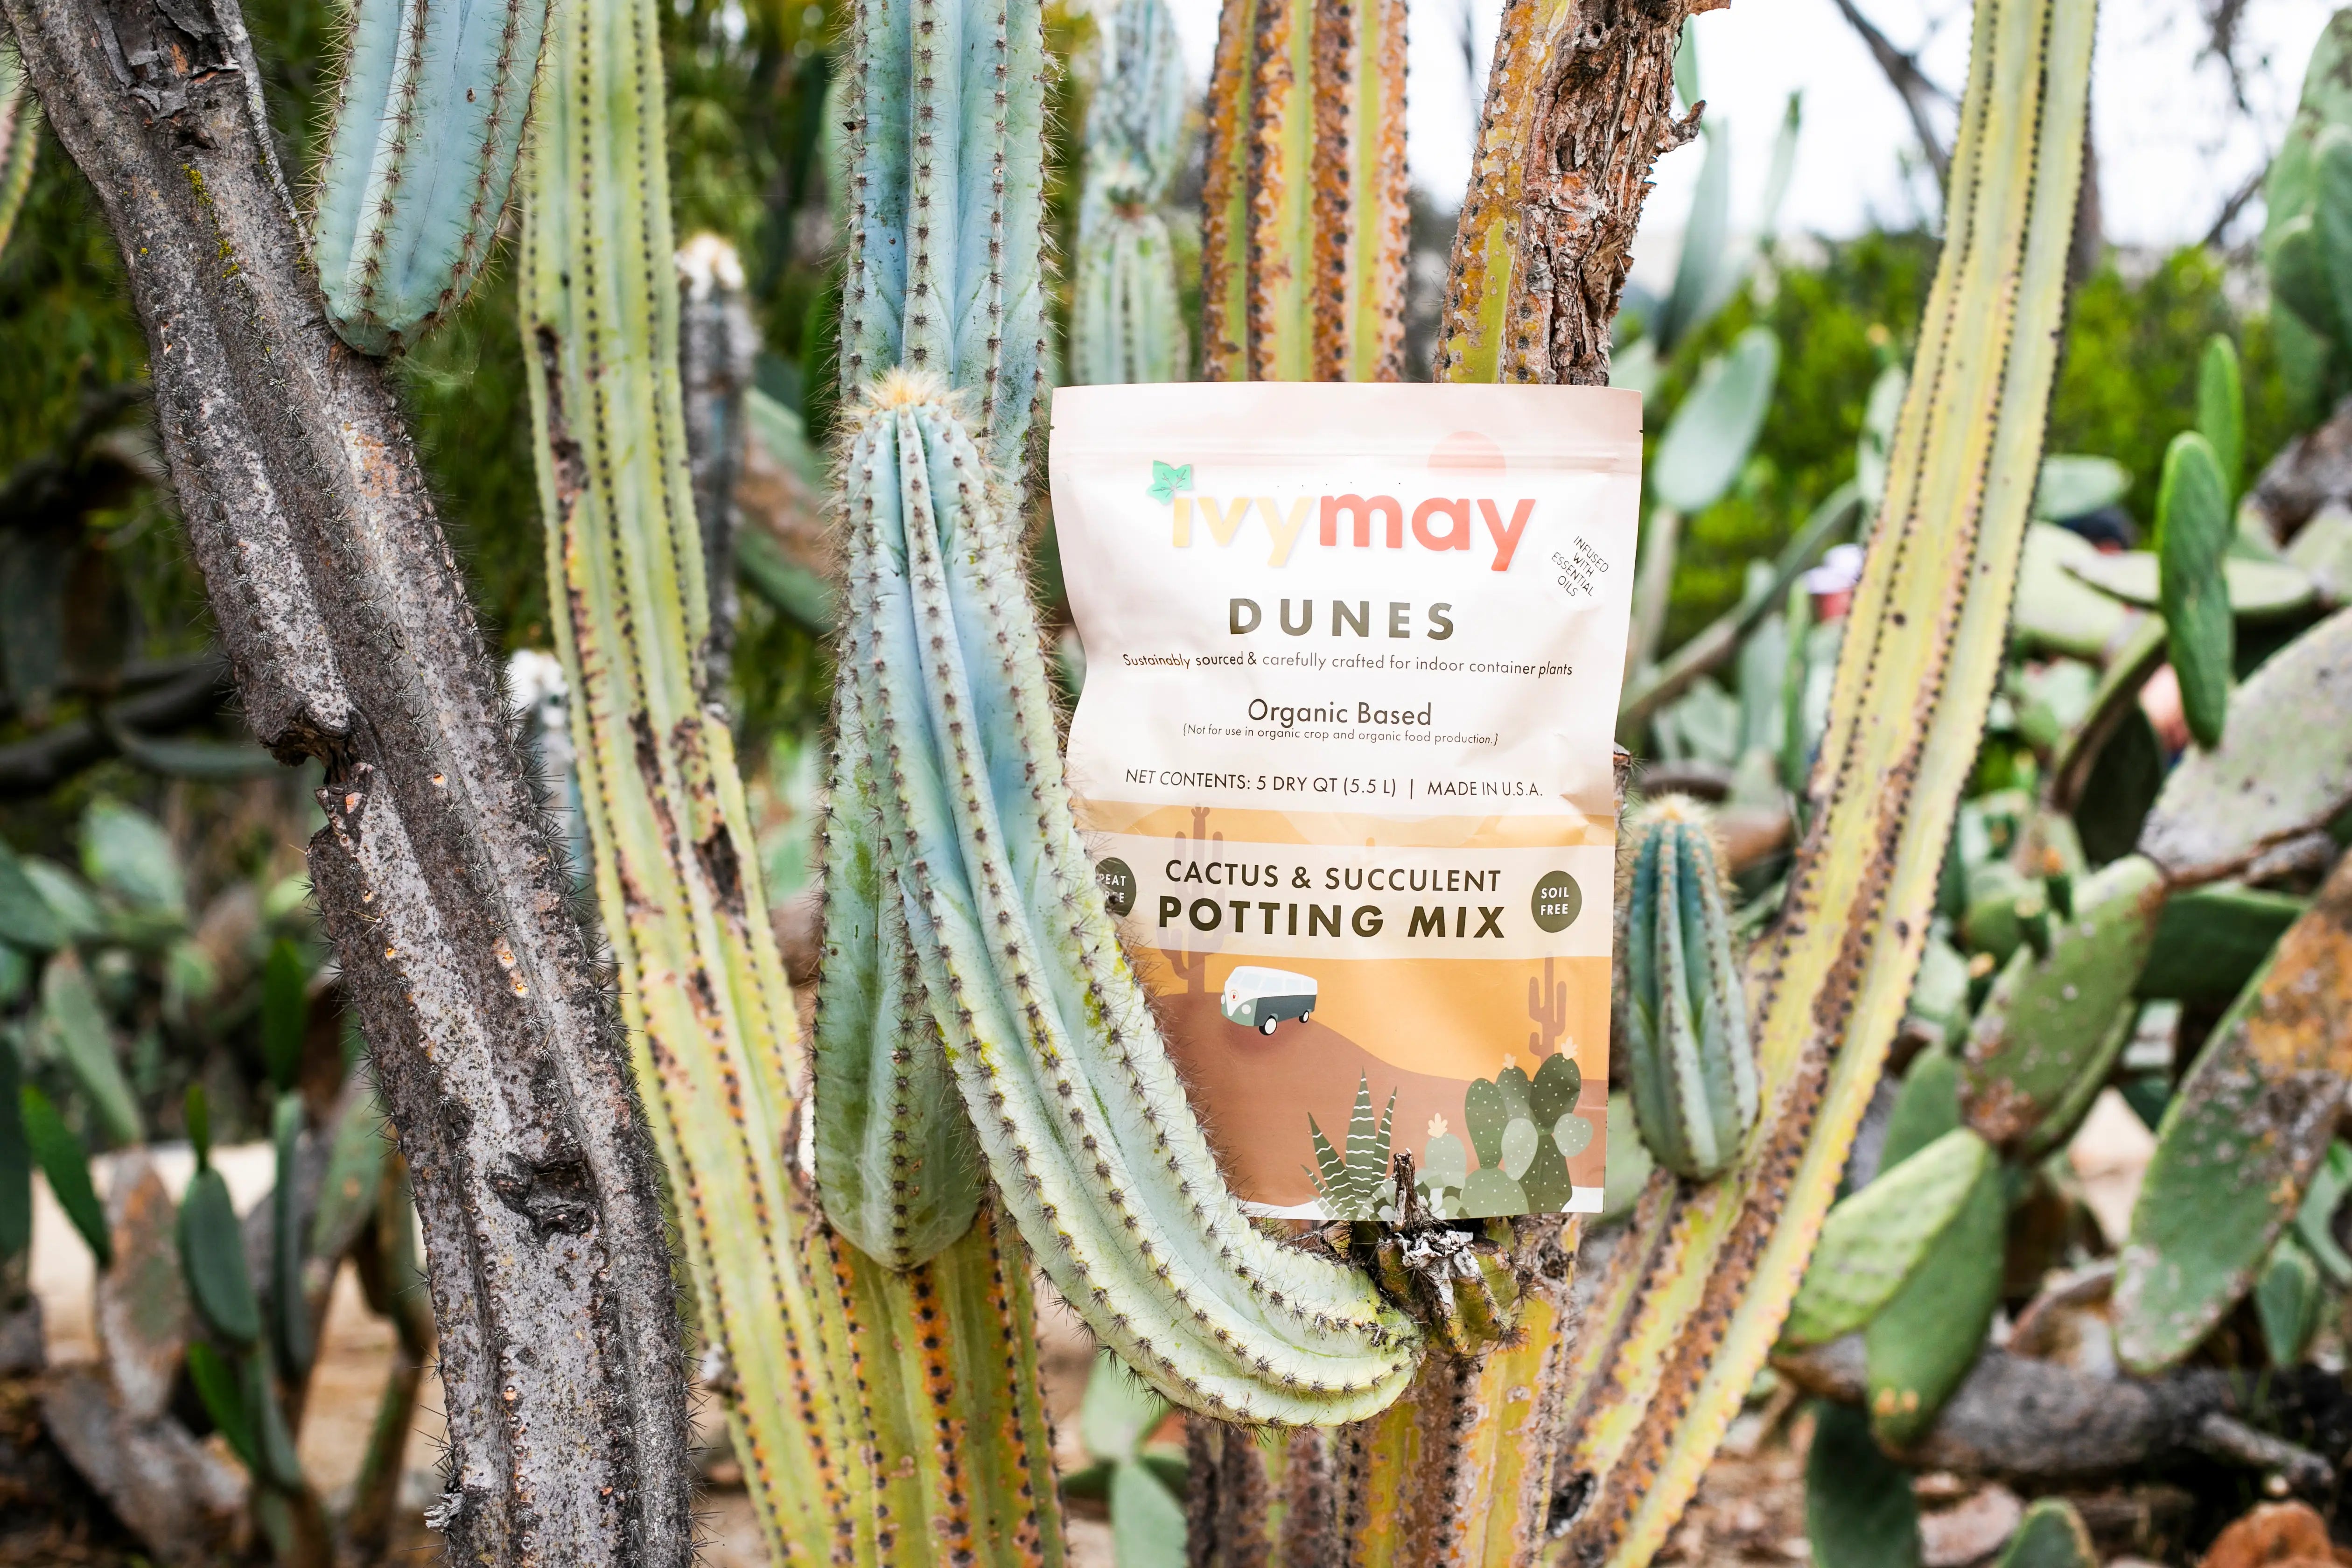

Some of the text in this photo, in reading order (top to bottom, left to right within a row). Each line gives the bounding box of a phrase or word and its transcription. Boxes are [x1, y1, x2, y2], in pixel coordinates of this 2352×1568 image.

[1172, 494, 1536, 572] ivymay
[1573, 552, 1594, 577] WITH
[1574, 536, 1609, 572] INFUSED
[1551, 552, 1593, 596] ESSENTIAL
[1558, 575, 1578, 596] OILS
[1229, 598, 1454, 640] DUNES
[1123, 651, 1572, 679] Sustainably sourced & carefully crafted for indoor container plants
[1246, 698, 1431, 728] Organic Based
[1208, 724, 1223, 735] for
[1245, 726, 1253, 736] in
[1258, 728, 1300, 741] organic
[1304, 731, 1329, 742] crop
[1333, 728, 1354, 740] and
[1358, 731, 1401, 743] organic
[1405, 730, 1430, 742] food
[1126, 768, 1156, 784] NET
[1160, 771, 1250, 790] CONTENTS:
[1256, 776, 1266, 790] 5
[1273, 776, 1308, 791] DRY
[1313, 777, 1338, 792] QT
[1344, 777, 1376, 797] (5.5
[1384, 778, 1396, 798] L)
[1427, 781, 1477, 796] MADE
[1482, 781, 1497, 796] IN
[1502, 782, 1542, 796] U.S.A.
[1166, 859, 1501, 891] CACTUS & SUCCULENT
[1541, 887, 1569, 899] SOIL
[1159, 896, 1505, 938] POTTING MIX
[1540, 903, 1568, 916] FREE
